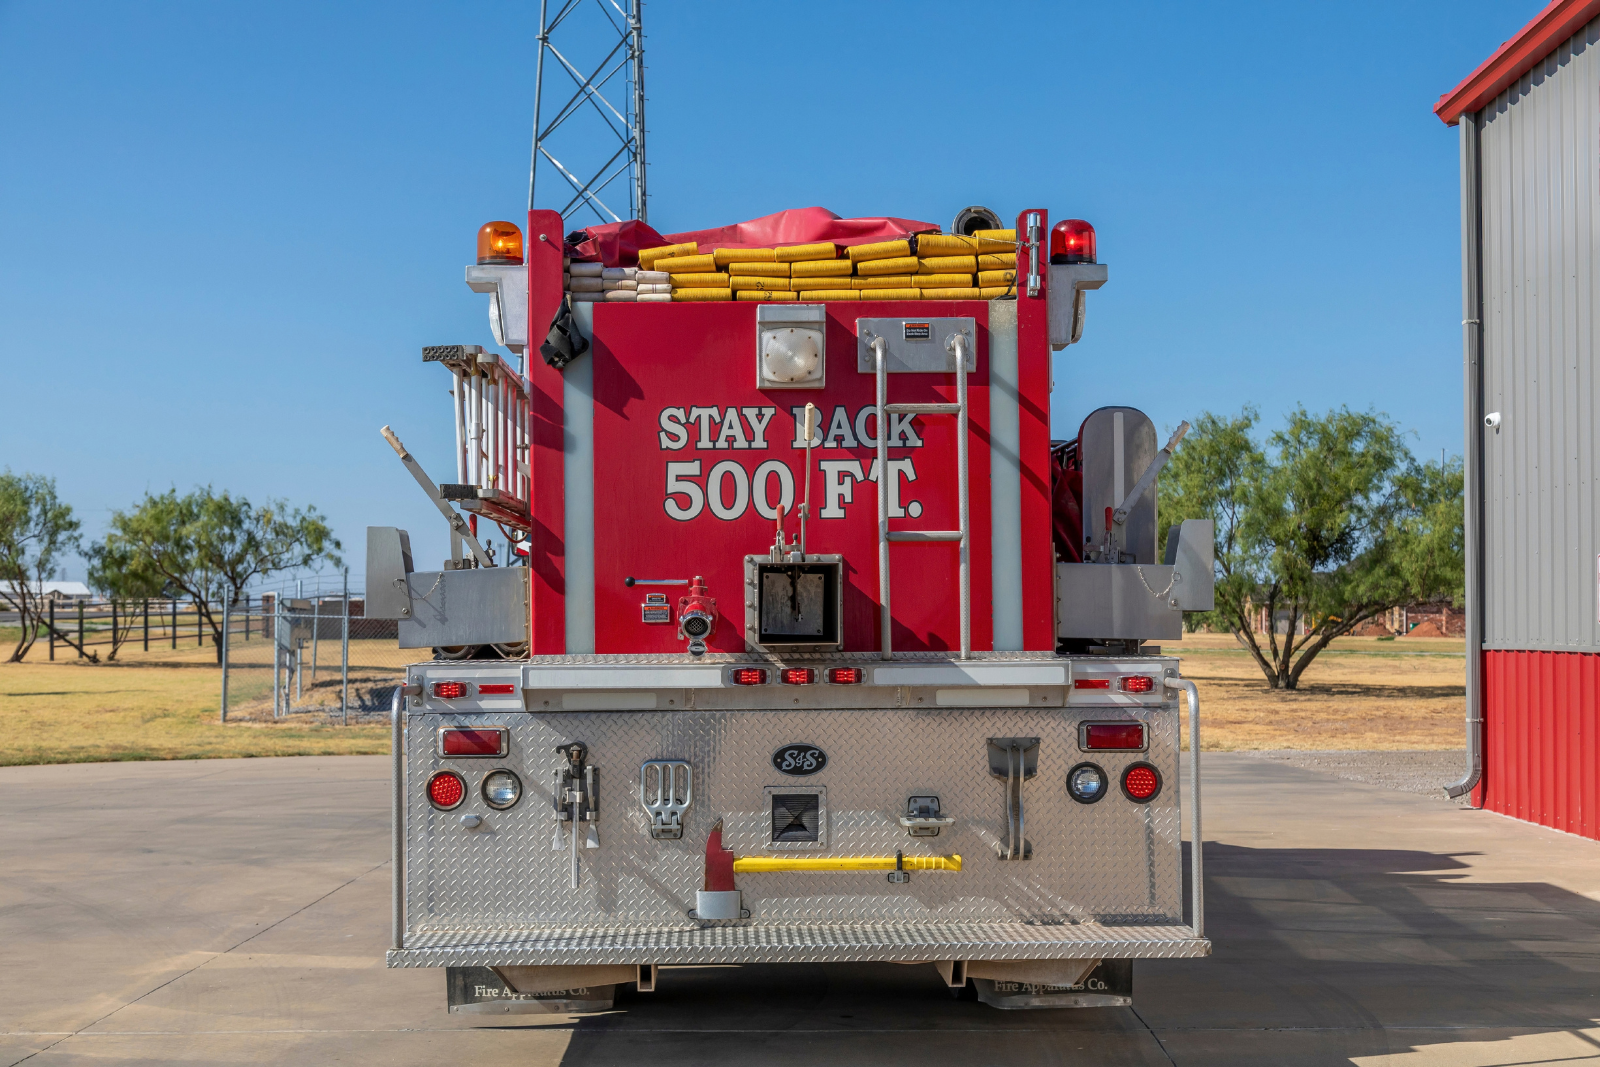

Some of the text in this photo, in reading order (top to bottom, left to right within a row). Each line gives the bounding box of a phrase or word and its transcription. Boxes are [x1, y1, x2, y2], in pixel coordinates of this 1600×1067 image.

[658, 404, 923, 451] STAY BACK
[663, 457, 924, 522] 500 FT.
[781, 749, 820, 770] S&S
[474, 985, 590, 1000] Fire Apptus Co.
[994, 980, 1019, 992] Fire
[1087, 978, 1108, 990] Co.
